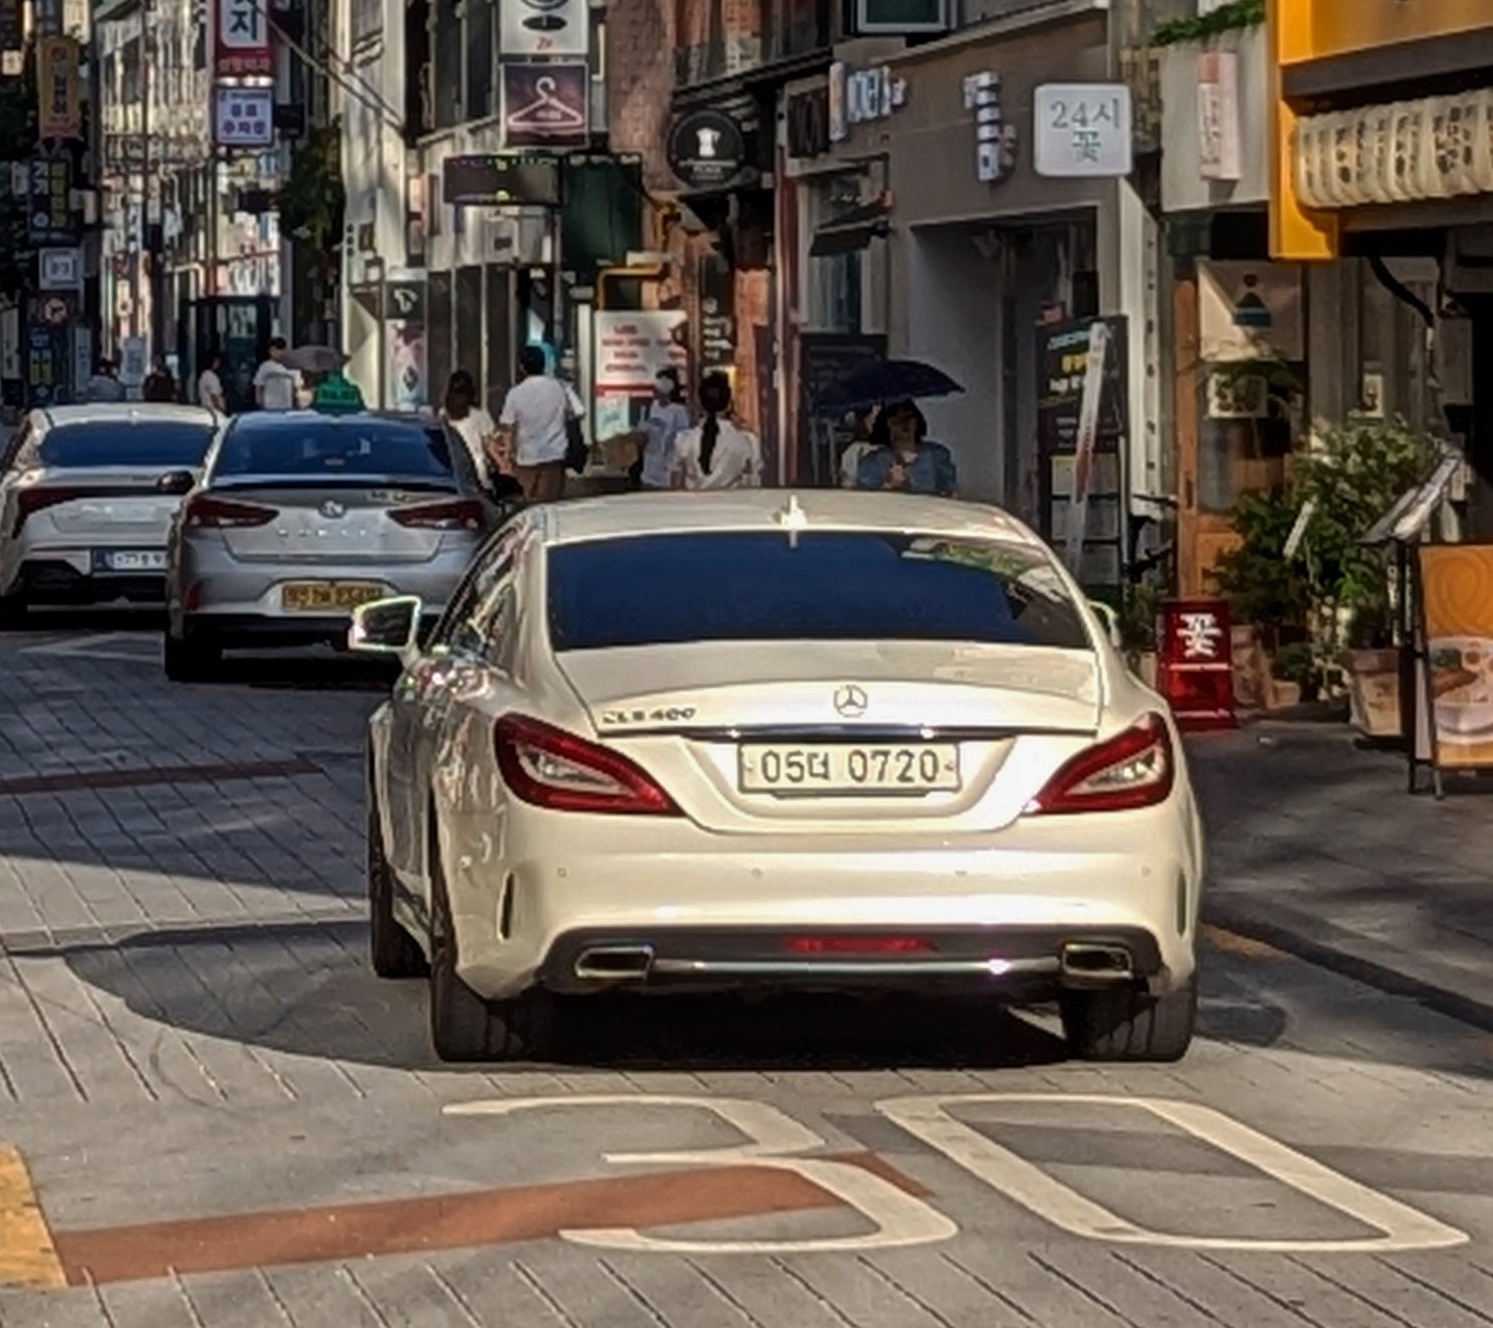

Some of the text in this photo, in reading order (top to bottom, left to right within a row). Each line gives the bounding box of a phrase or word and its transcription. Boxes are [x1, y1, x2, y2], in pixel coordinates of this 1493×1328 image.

[1049, 100, 1121, 133] 24시
[650, 707, 696, 721] 400
[761, 749, 939, 783] 05더 0720
